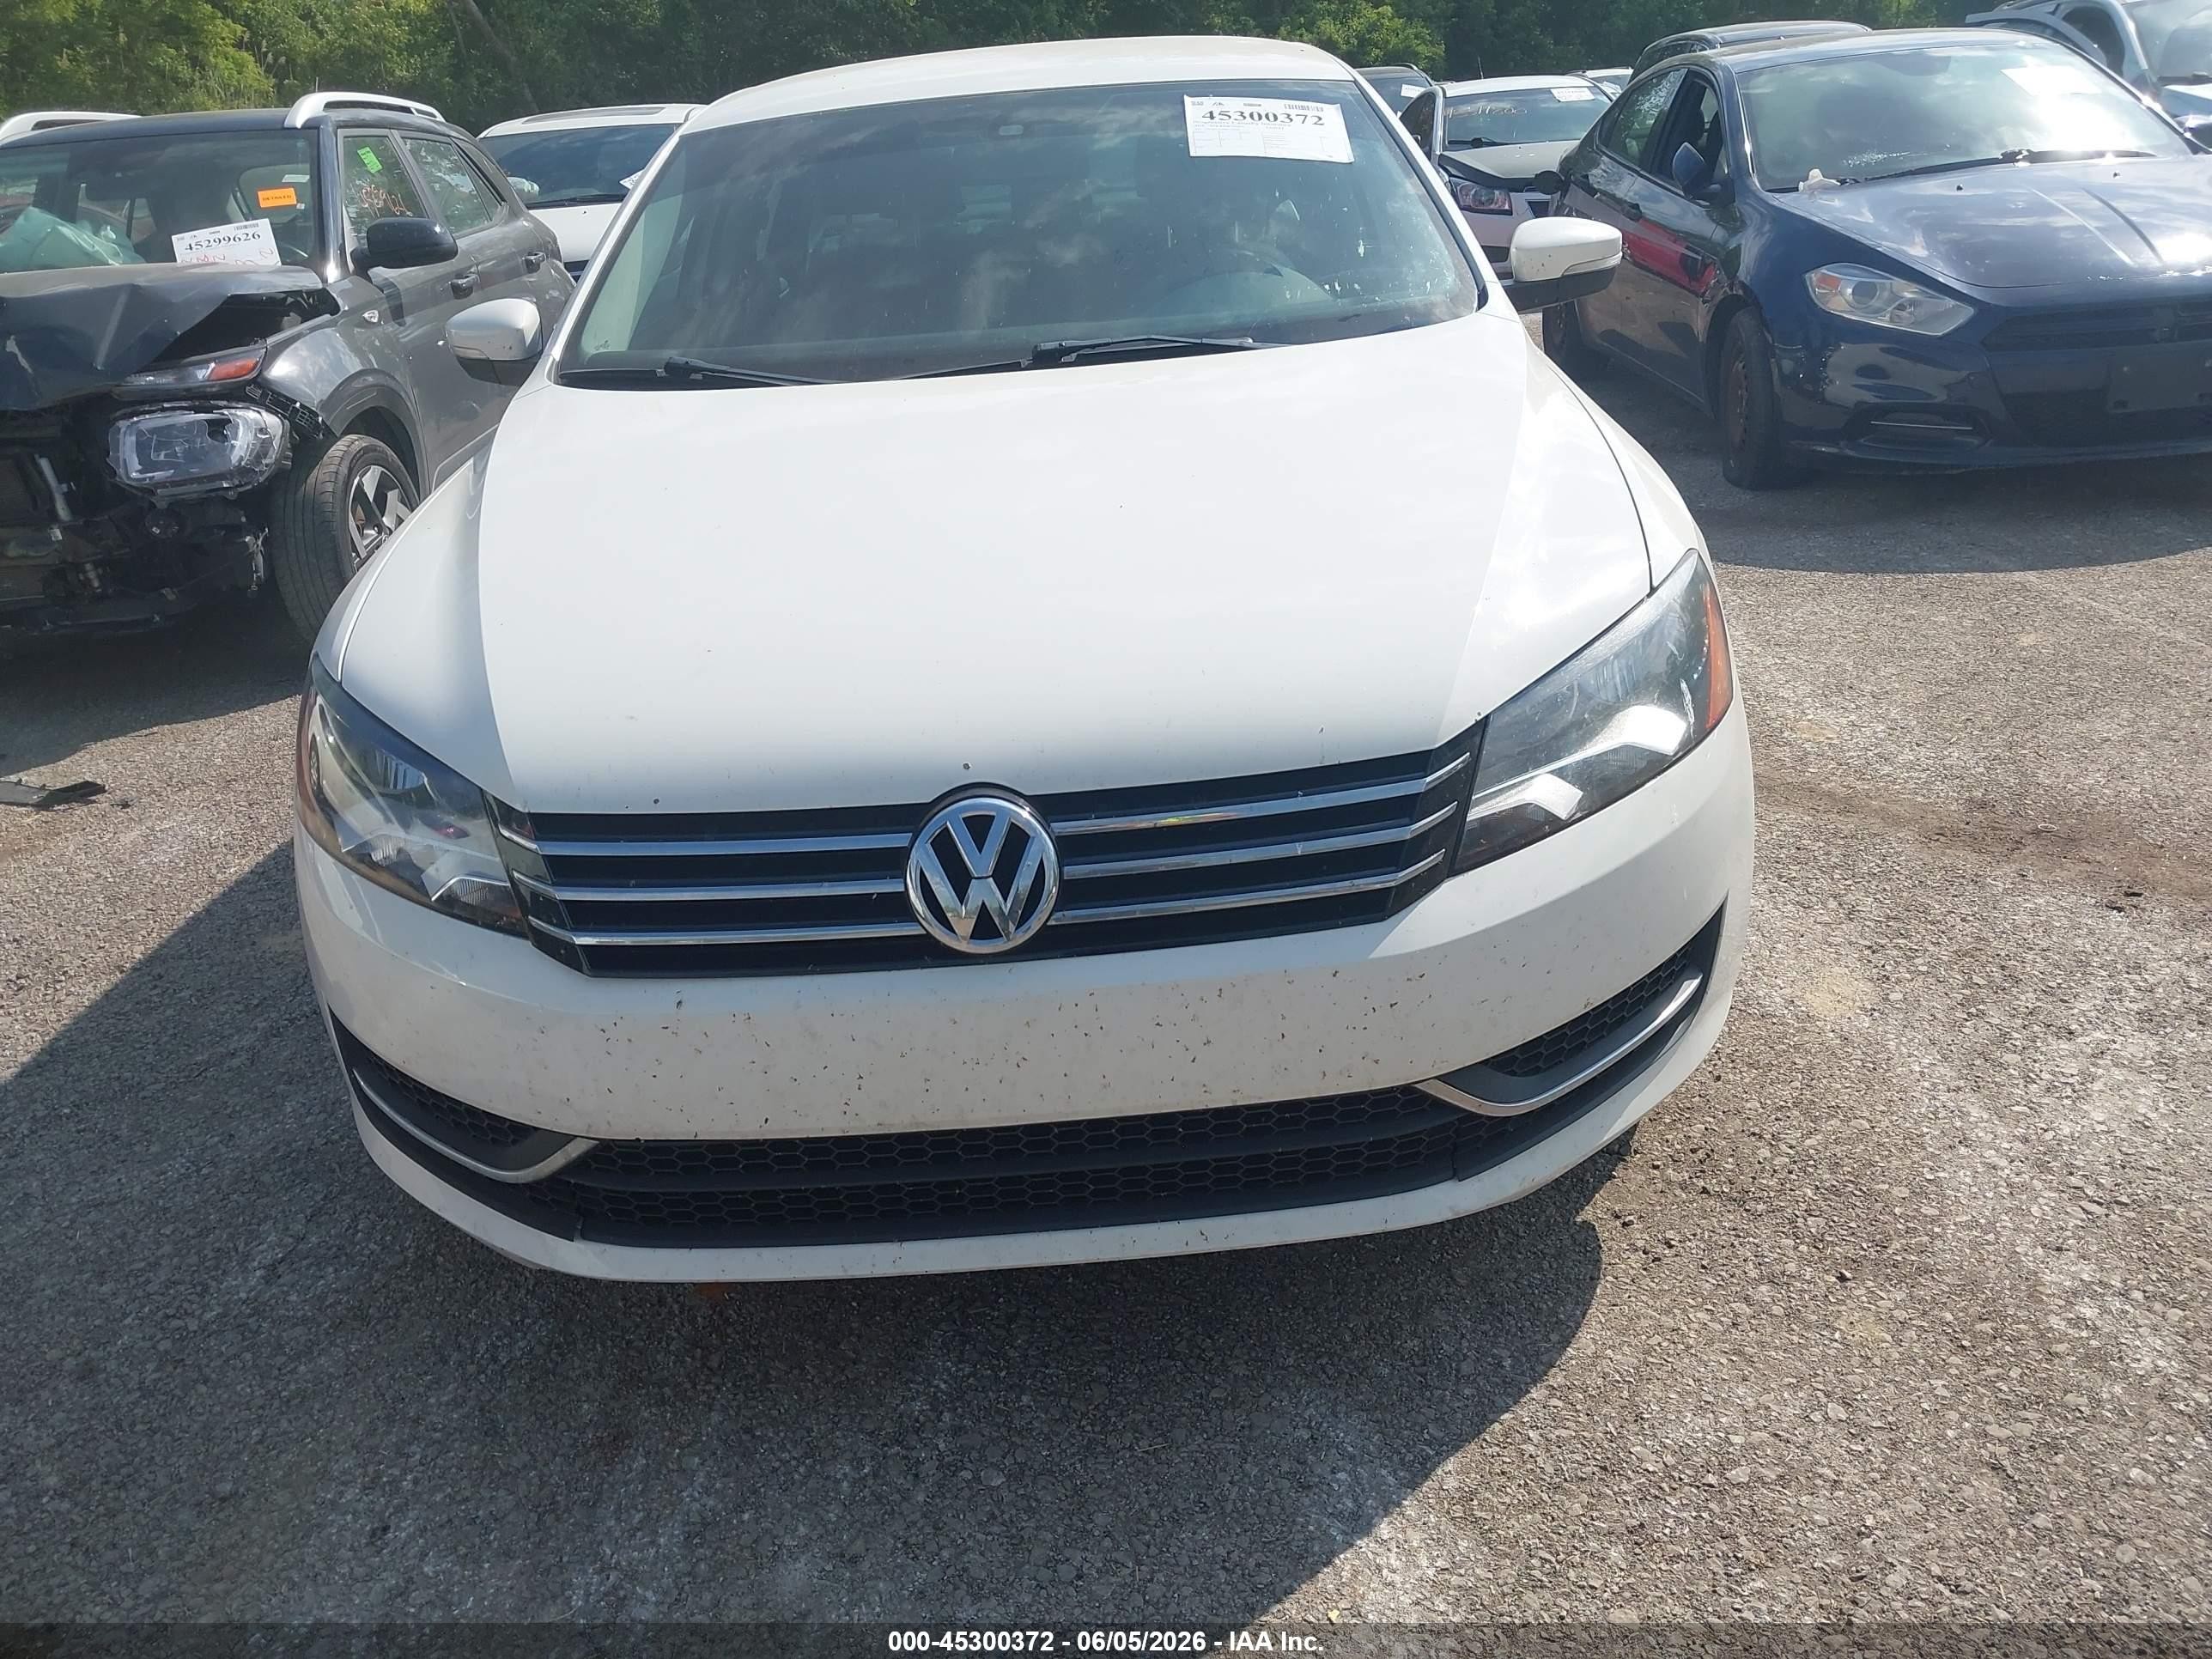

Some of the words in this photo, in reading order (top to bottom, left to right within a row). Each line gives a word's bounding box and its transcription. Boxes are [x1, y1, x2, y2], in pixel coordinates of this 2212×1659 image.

[1200, 109, 1326, 126] 45300372
[184, 230, 262, 252] 45299626
[912, 807, 1052, 947] VW
